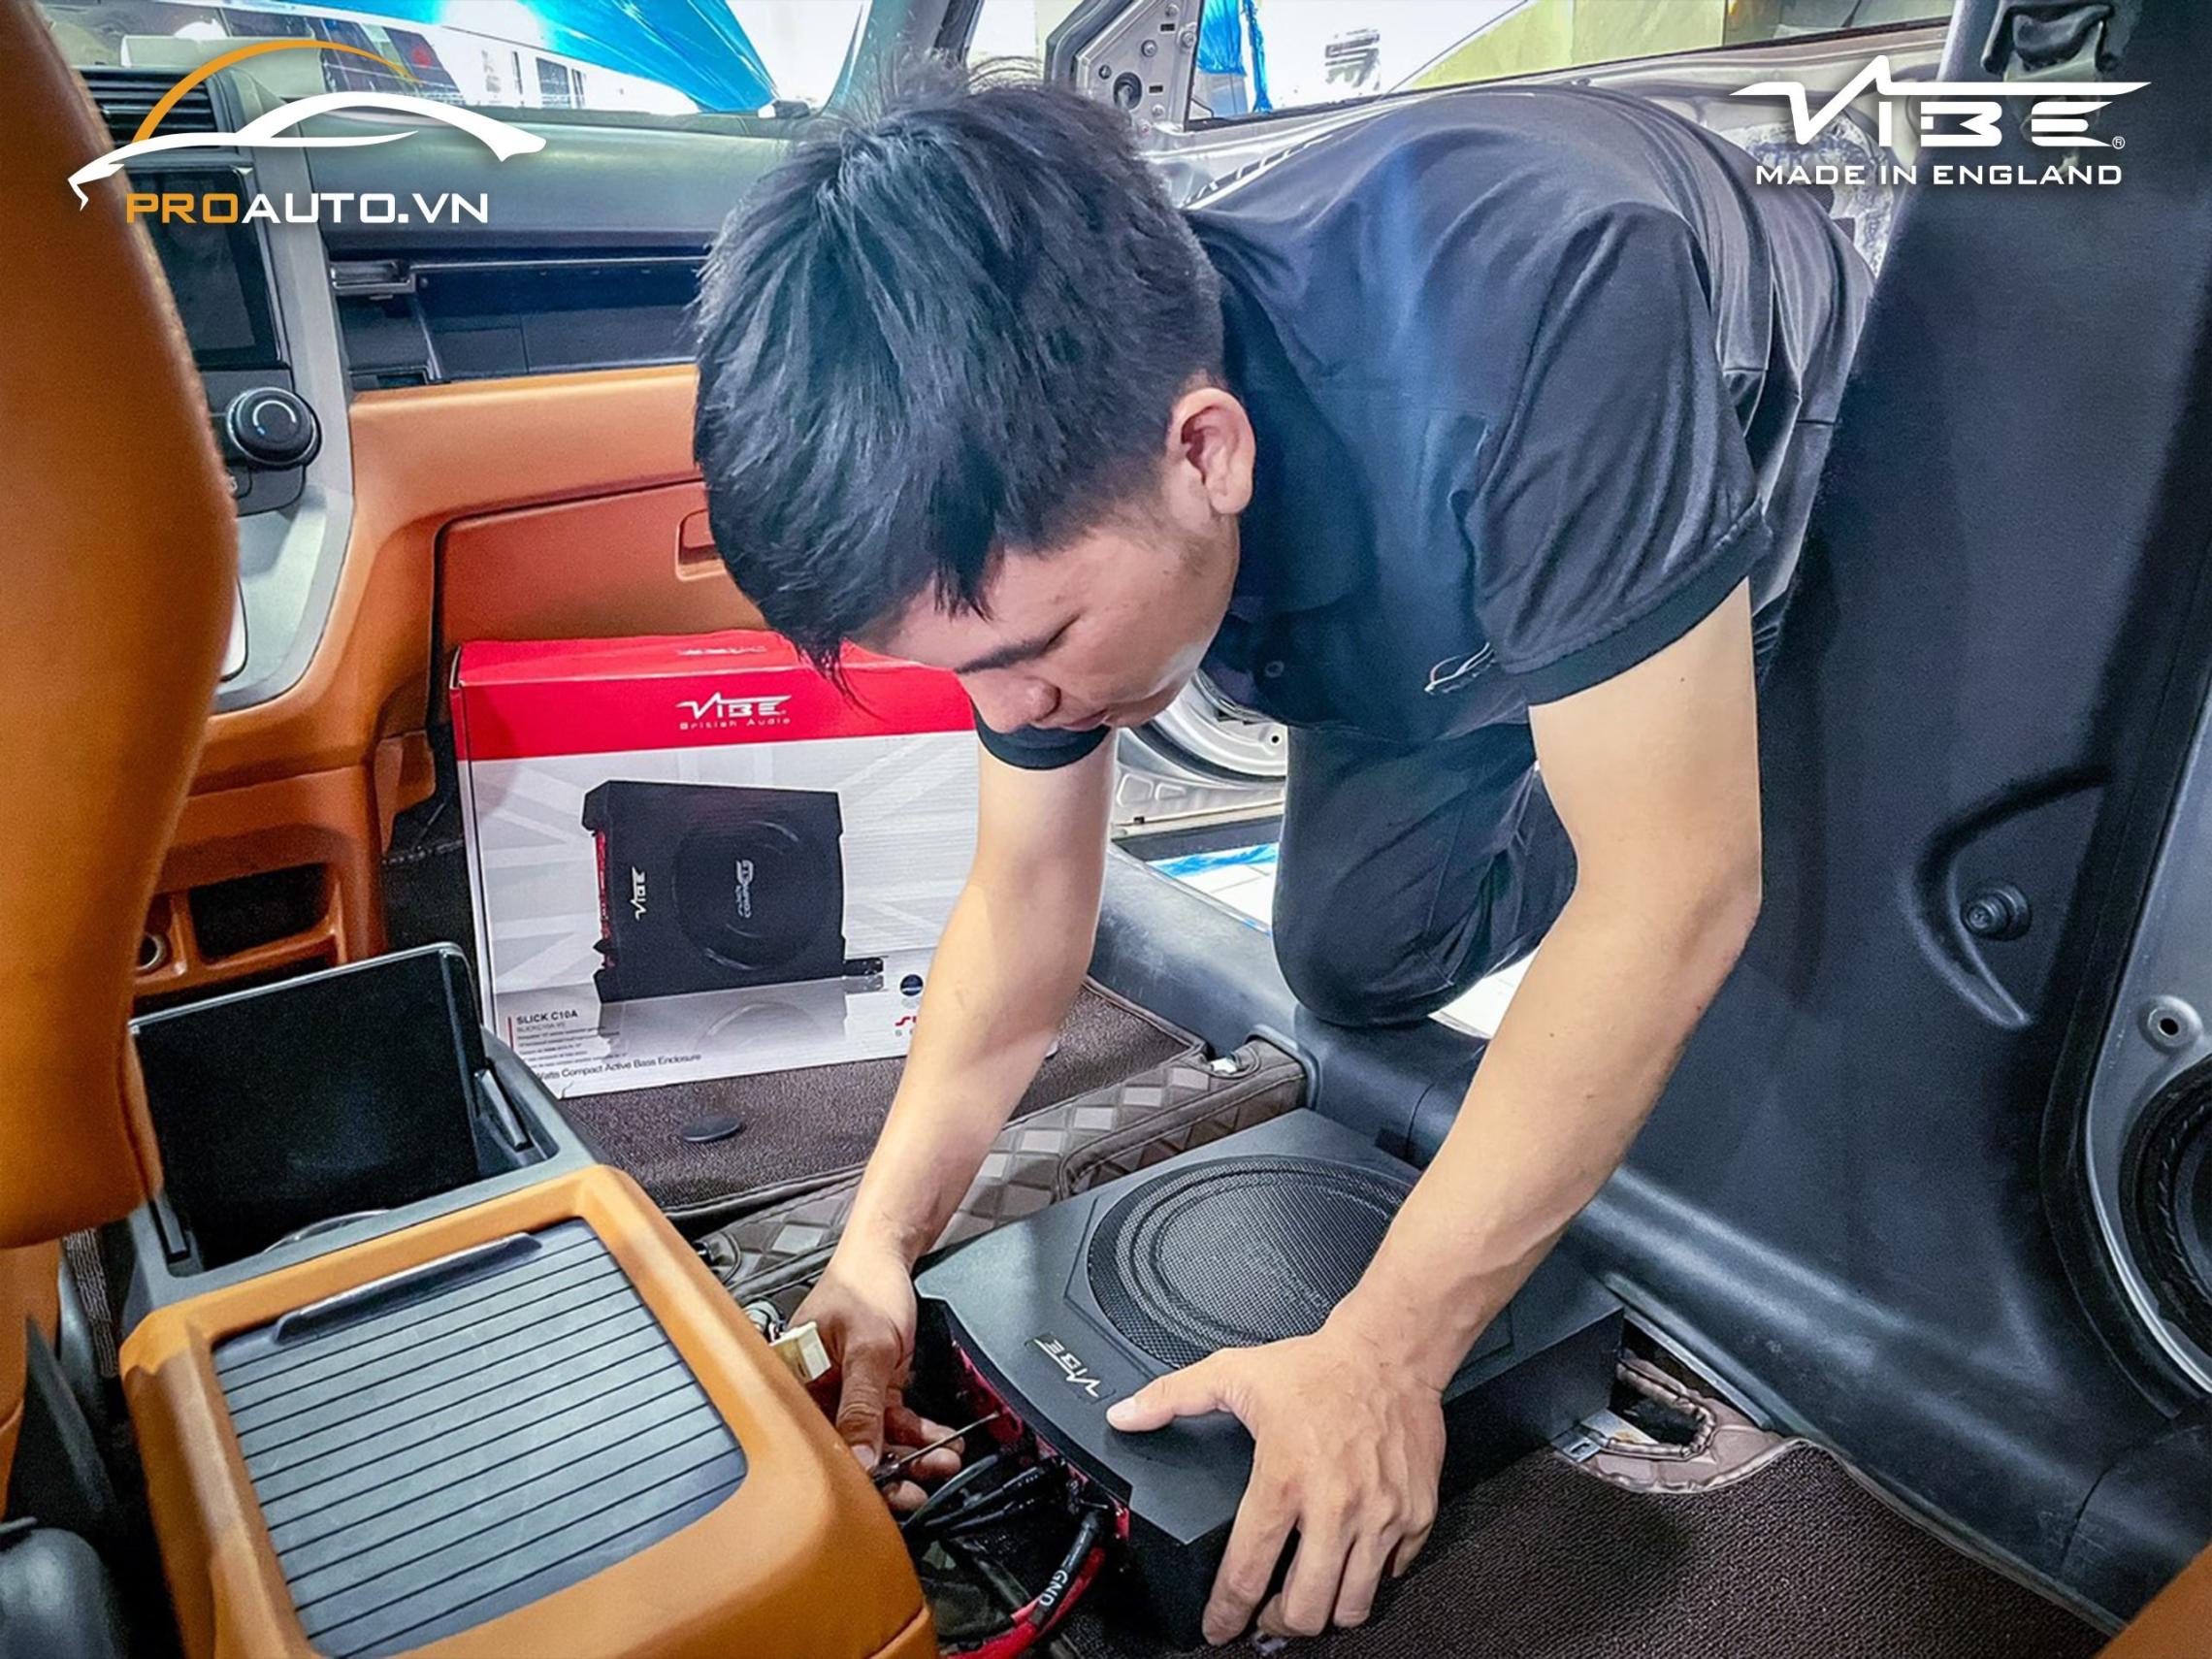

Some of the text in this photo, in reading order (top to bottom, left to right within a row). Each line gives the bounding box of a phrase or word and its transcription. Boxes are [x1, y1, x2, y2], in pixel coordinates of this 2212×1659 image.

[676, 692, 792, 719] VIBE
[679, 717, 791, 731] British Audio
[630, 866, 647, 921] VIBE
[516, 1009, 578, 1025] SLICK C10A
[561, 1064, 603, 1078] Compact
[604, 1060, 632, 1072] Active
[633, 1058, 657, 1069] Bass
[658, 1054, 701, 1065] Enclosure
[1033, 1339, 1100, 1397] VIBE
[1039, 1570, 1068, 1607] GND
